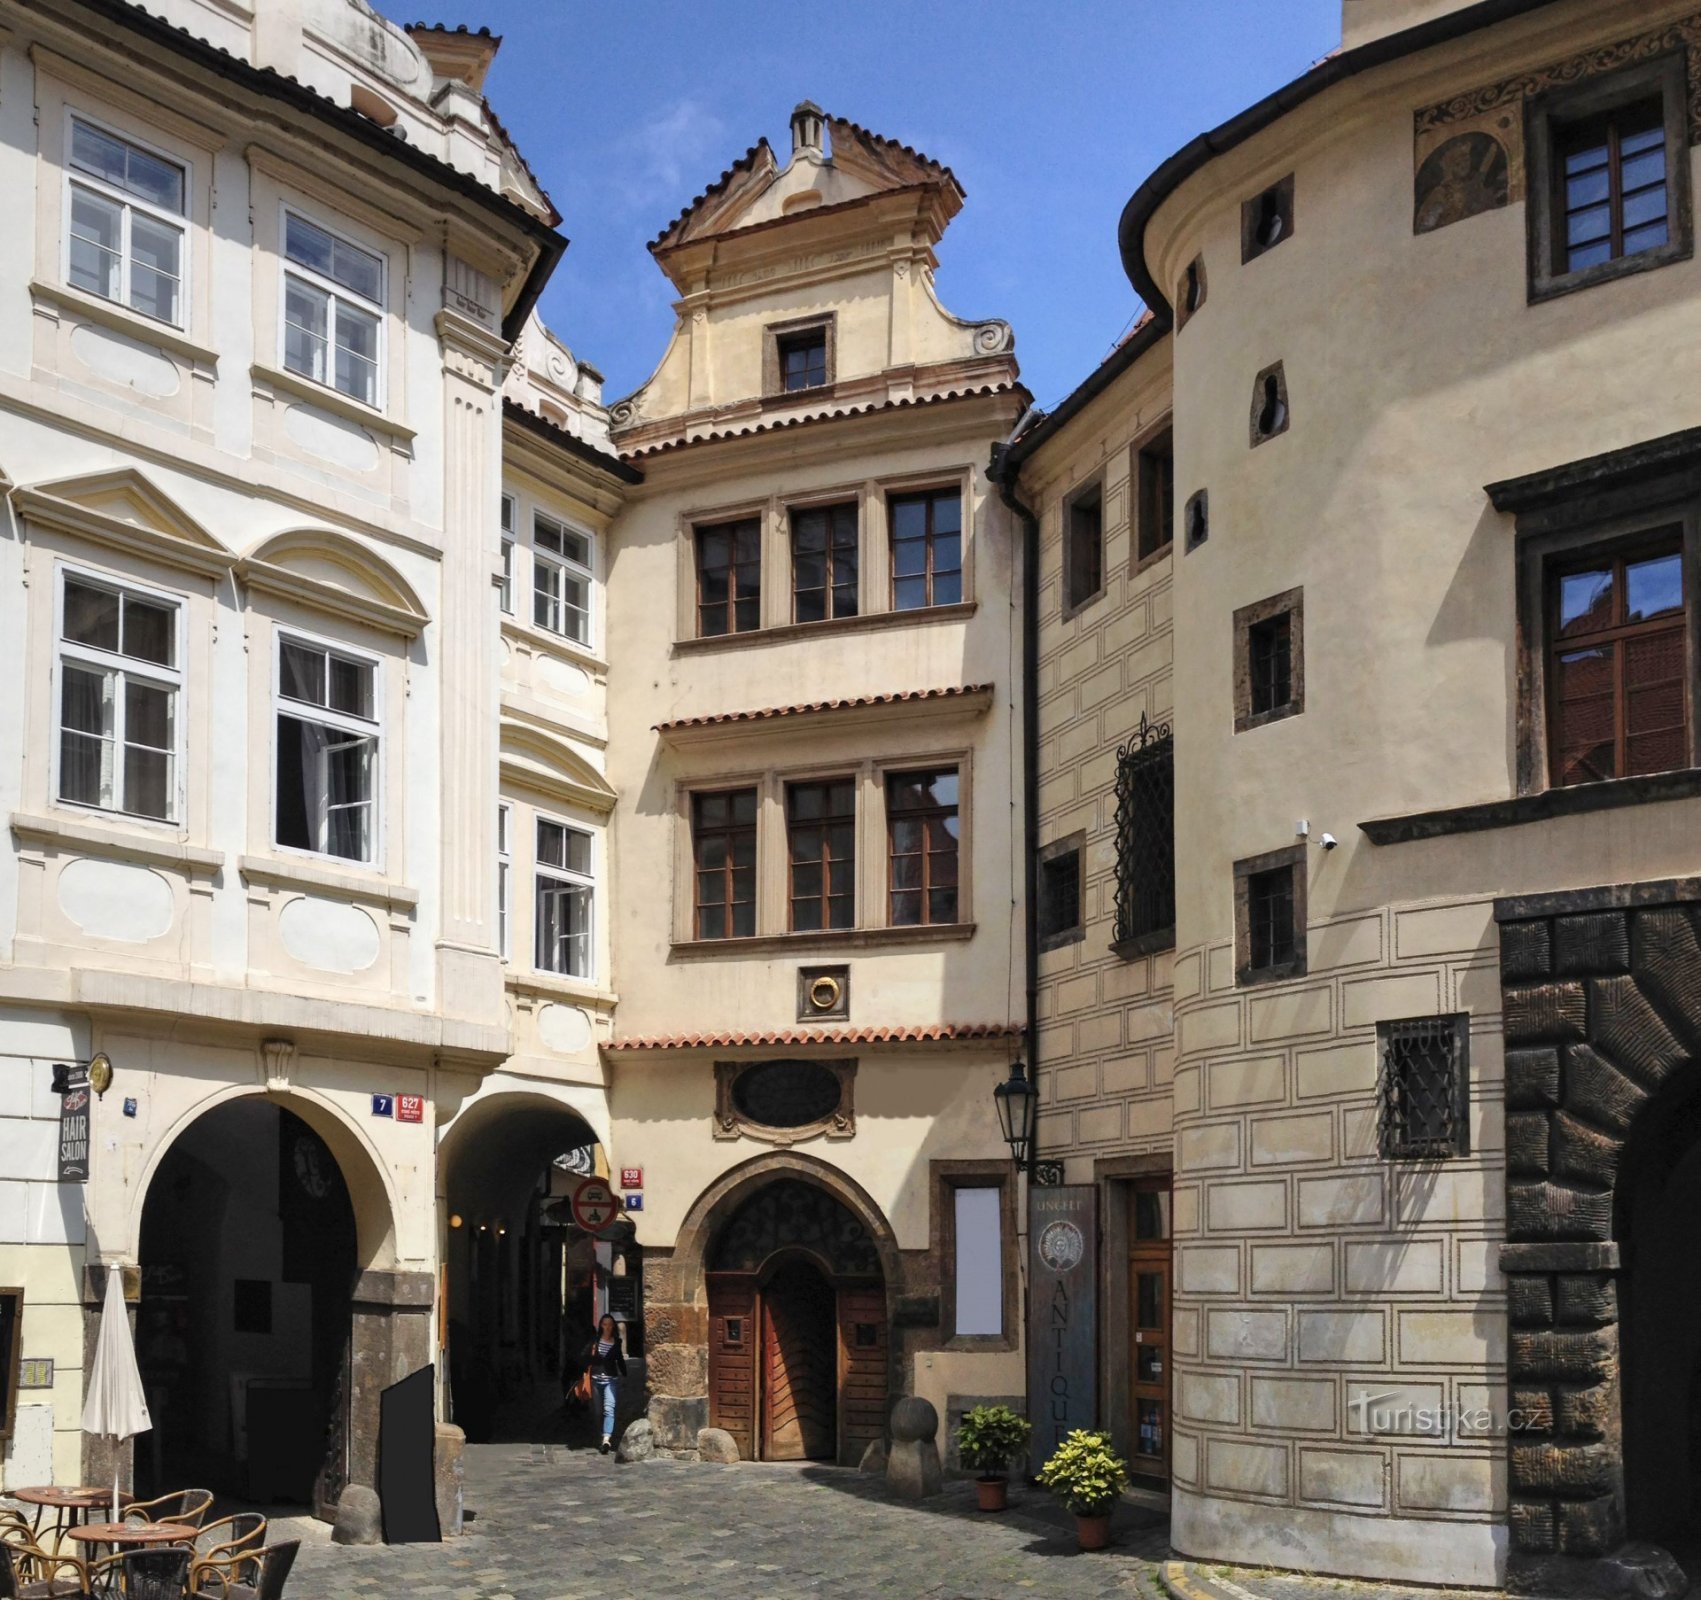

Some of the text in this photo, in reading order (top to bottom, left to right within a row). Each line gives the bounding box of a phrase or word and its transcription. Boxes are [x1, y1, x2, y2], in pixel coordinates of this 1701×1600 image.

[380, 1098, 387, 1111] 7
[402, 1097, 419, 1109] 627
[62, 1115, 87, 1141] HAIR
[61, 1141, 87, 1162] SALON
[624, 1170, 638, 1179] 630
[631, 1197, 637, 1206] 6
